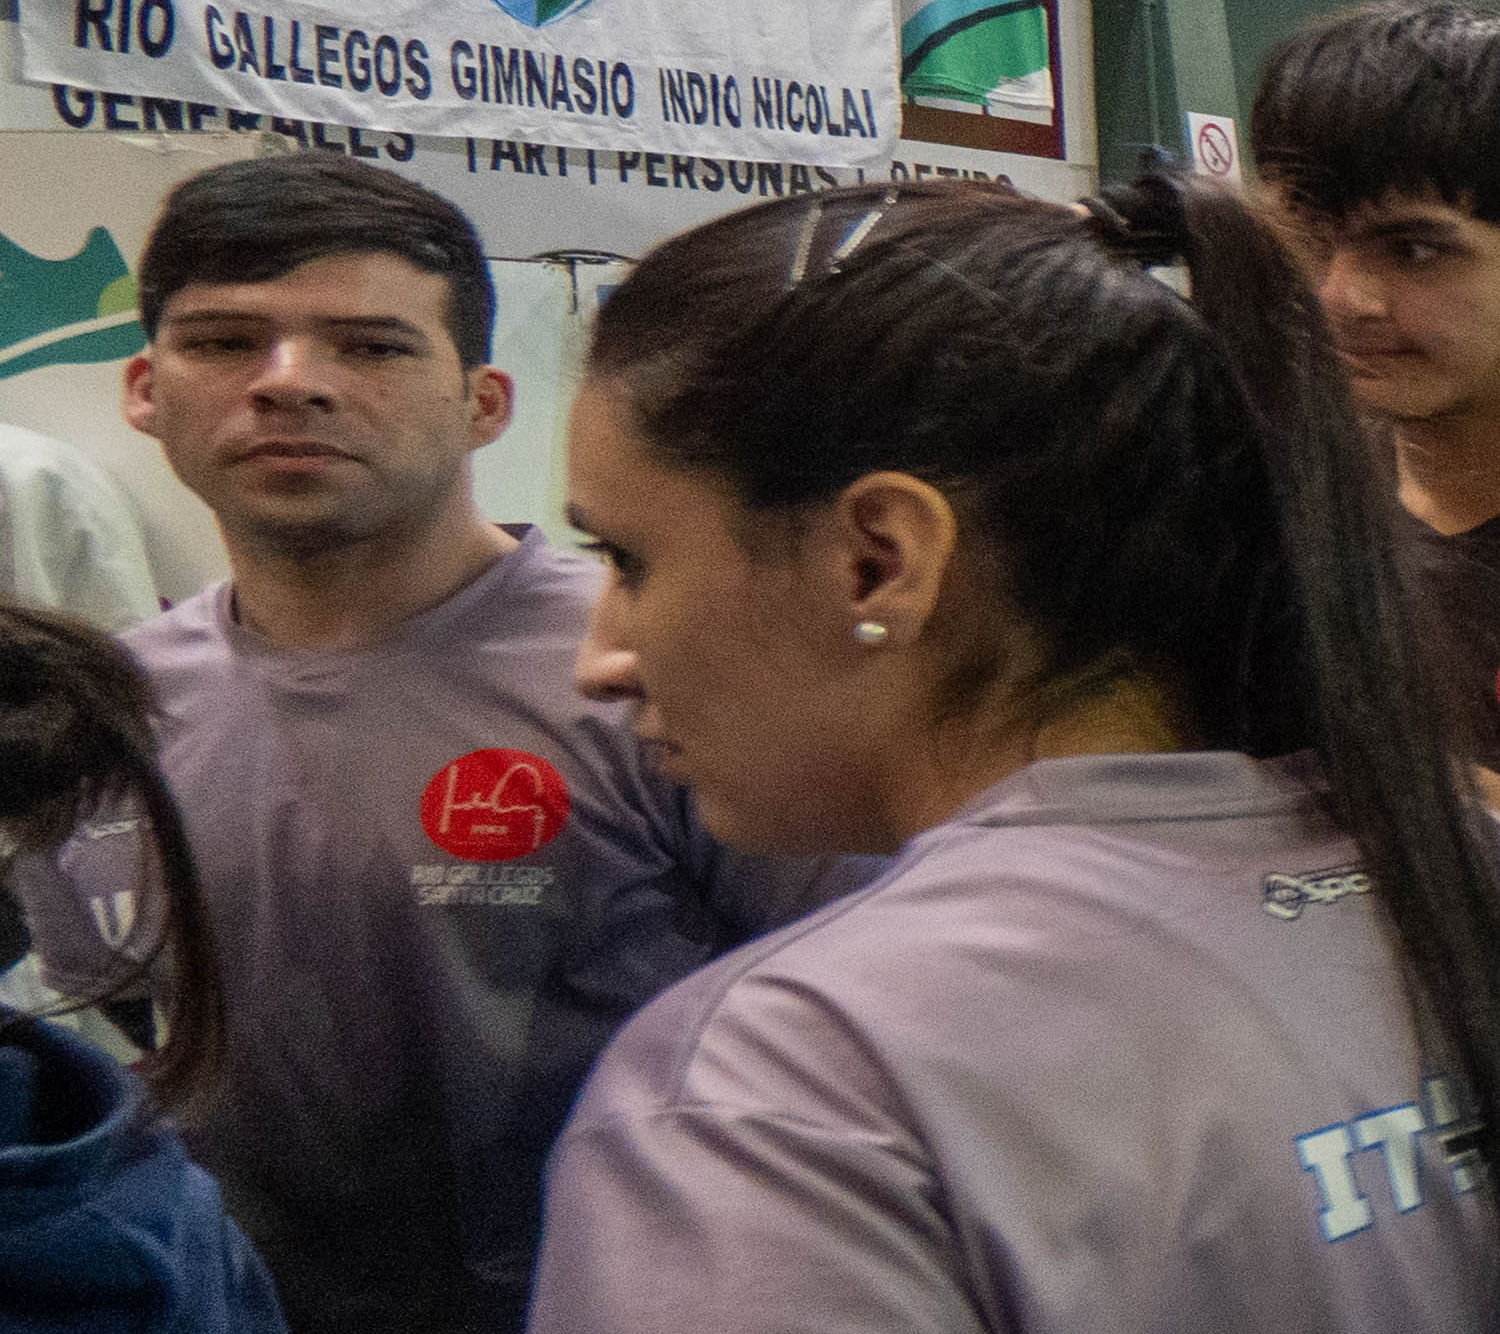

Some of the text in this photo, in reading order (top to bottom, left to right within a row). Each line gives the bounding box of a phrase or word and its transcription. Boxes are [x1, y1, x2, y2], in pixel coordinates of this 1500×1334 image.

[205, 4, 432, 100] GALLEGOS
[450, 40, 634, 119] GIMNASIO
[659, 67, 742, 128] INDIO
[753, 75, 878, 138] NICOLAI
[620, 151, 839, 196] PERSONAS
[484, 885, 543, 905] CRUZ
